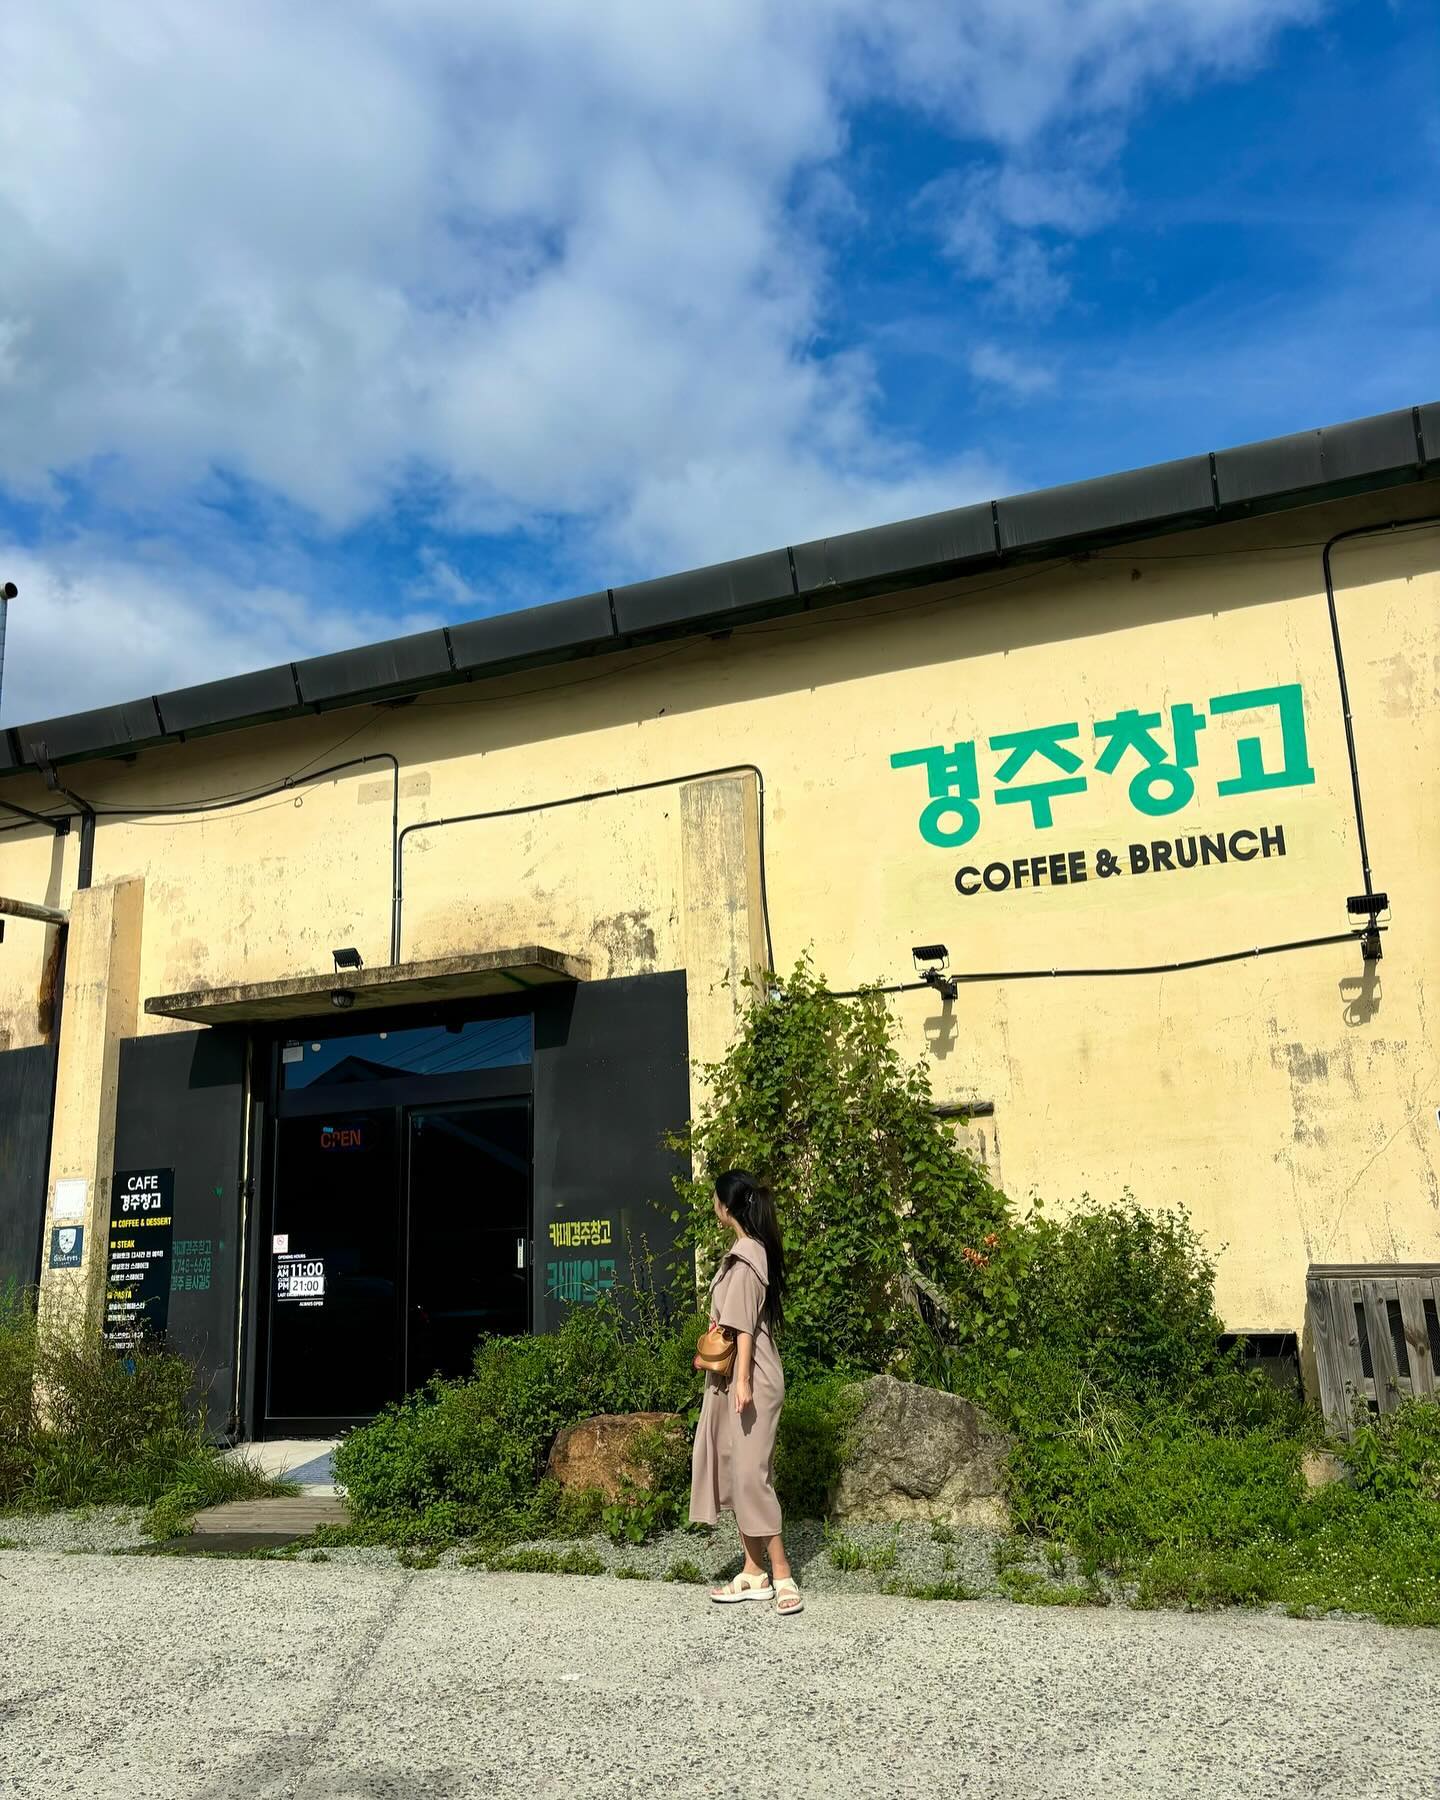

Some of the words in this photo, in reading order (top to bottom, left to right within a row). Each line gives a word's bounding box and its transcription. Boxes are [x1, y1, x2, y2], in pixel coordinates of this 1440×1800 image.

[889, 683, 1316, 848] 경주창고
[954, 850, 1088, 896] COFFEE
[1095, 848, 1123, 879] &
[1128, 824, 1287, 875] BRUNCH
[320, 1129, 361, 1149] OPEN
[127, 1175, 159, 1191] CAFE
[120, 1192, 162, 1212] 경주창고
[118, 1218, 139, 1228] COFFEE
[140, 1218, 145, 1227] &
[146, 1216, 172, 1226] DESSERT
[549, 1219, 612, 1247] 카페경주창고
[117, 1239, 135, 1249] STEAK
[277, 1269, 289, 1278] AM
[290, 1262, 324, 1277] 11:00
[277, 1282, 289, 1291] PM
[292, 1280, 319, 1291] 21:00
